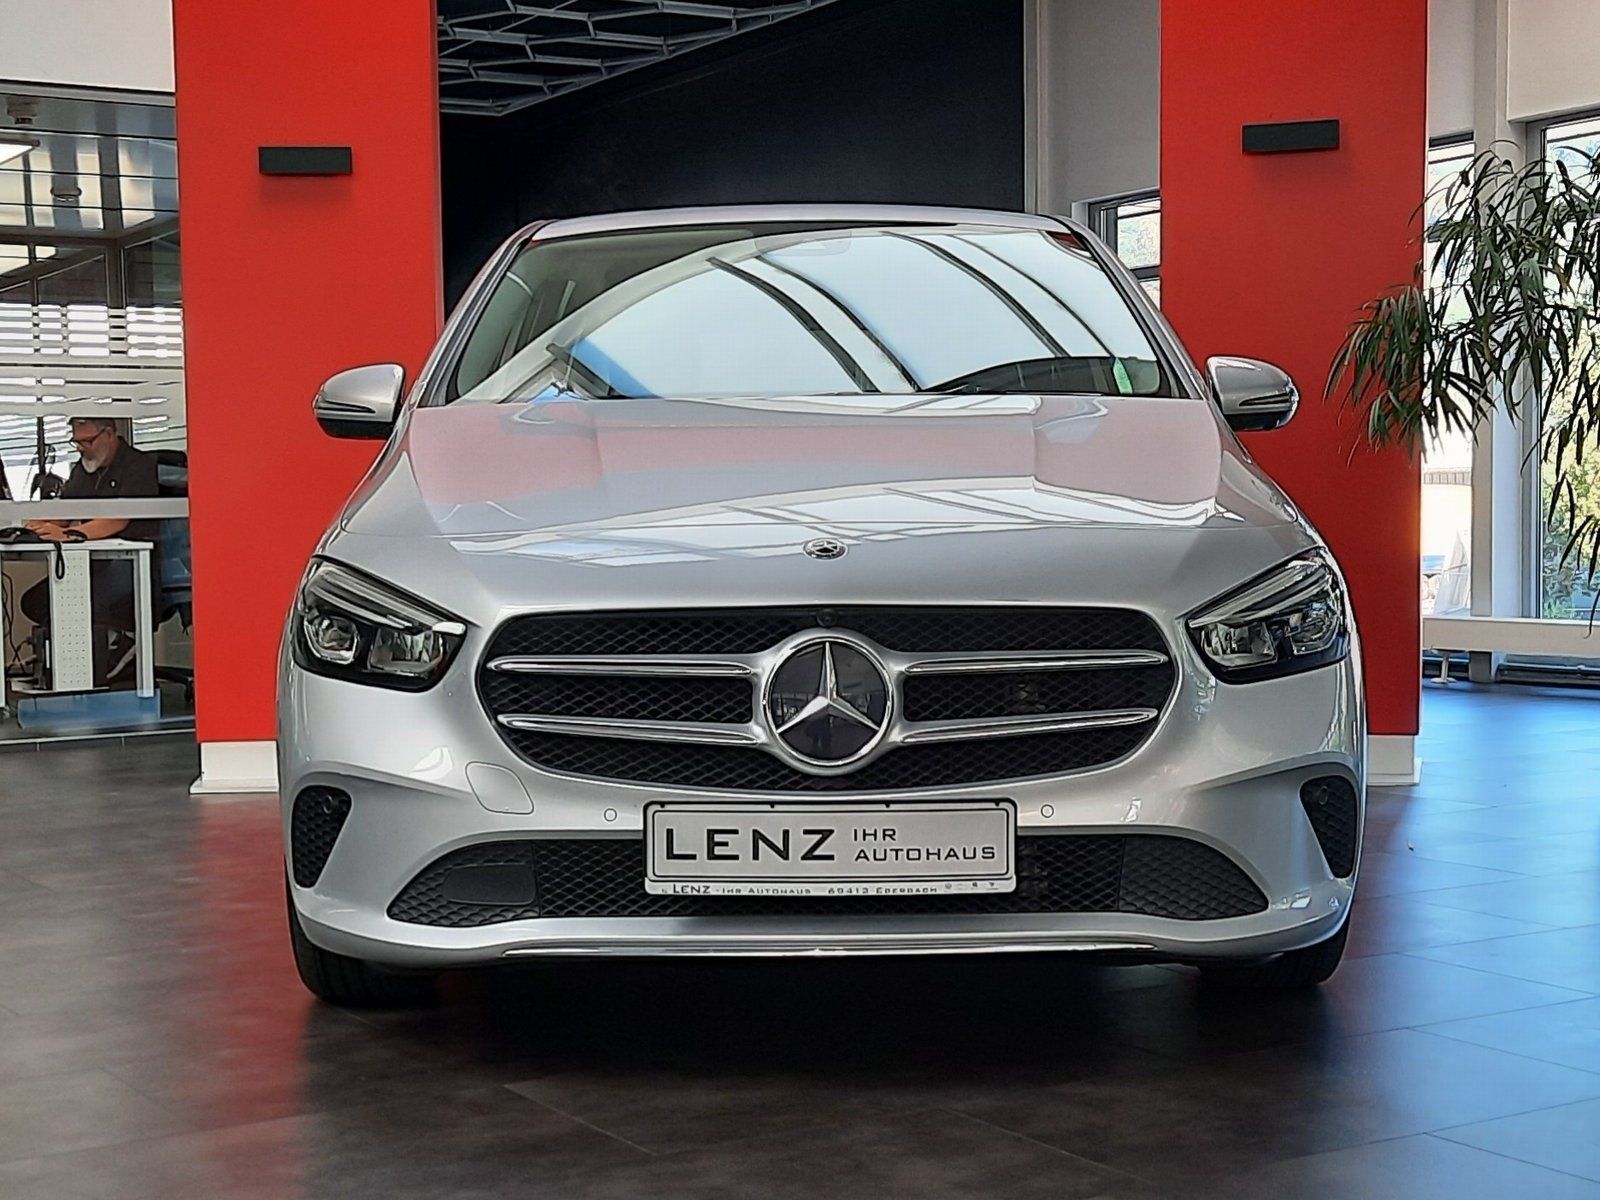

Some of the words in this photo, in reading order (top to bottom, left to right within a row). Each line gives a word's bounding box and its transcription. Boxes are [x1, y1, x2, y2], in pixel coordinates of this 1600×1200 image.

[853, 828, 897, 842] IHR
[666, 828, 835, 861] LENZ
[854, 846, 996, 862] AUTOHAUS
[673, 883, 711, 895] LENZ
[748, 886, 811, 895] AUTOHAUS
